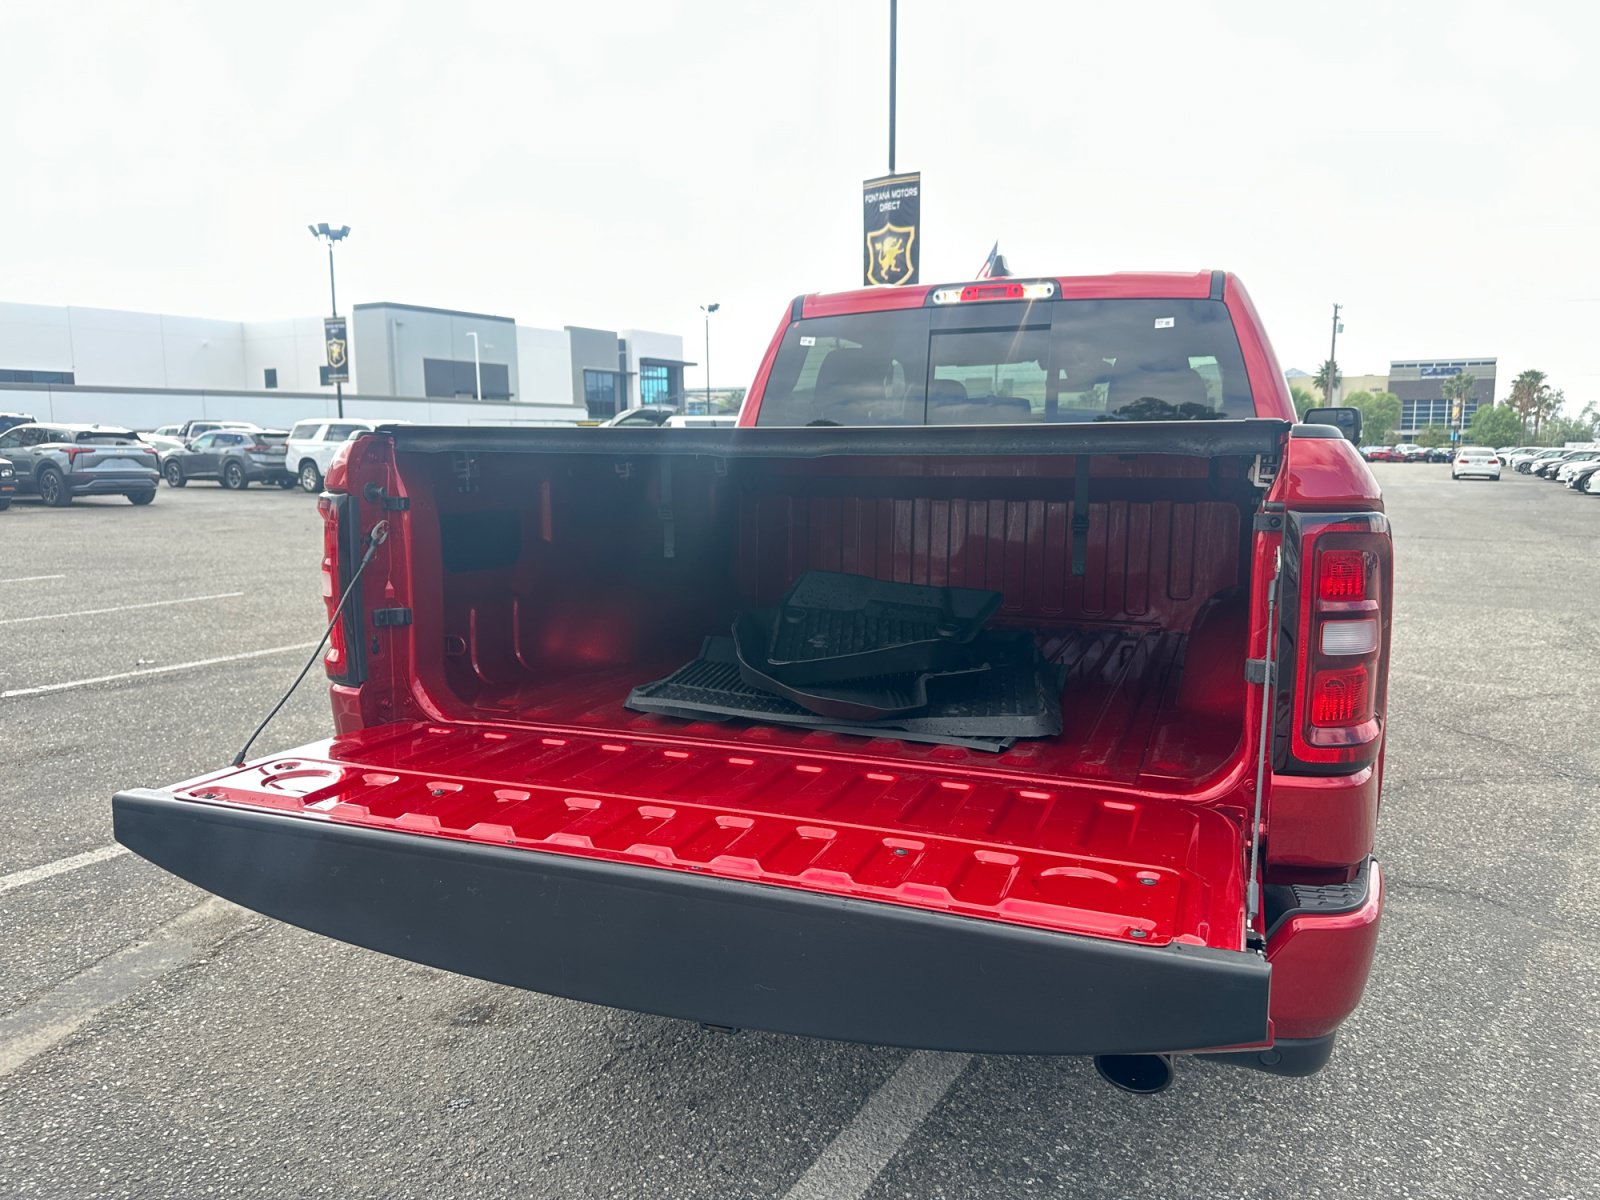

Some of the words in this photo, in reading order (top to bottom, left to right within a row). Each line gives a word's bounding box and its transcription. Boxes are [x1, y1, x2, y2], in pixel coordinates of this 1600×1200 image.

[865, 191, 890, 204] FONTANA
[891, 187, 917, 198] MOTORS
[879, 200, 900, 212] DIRECT
